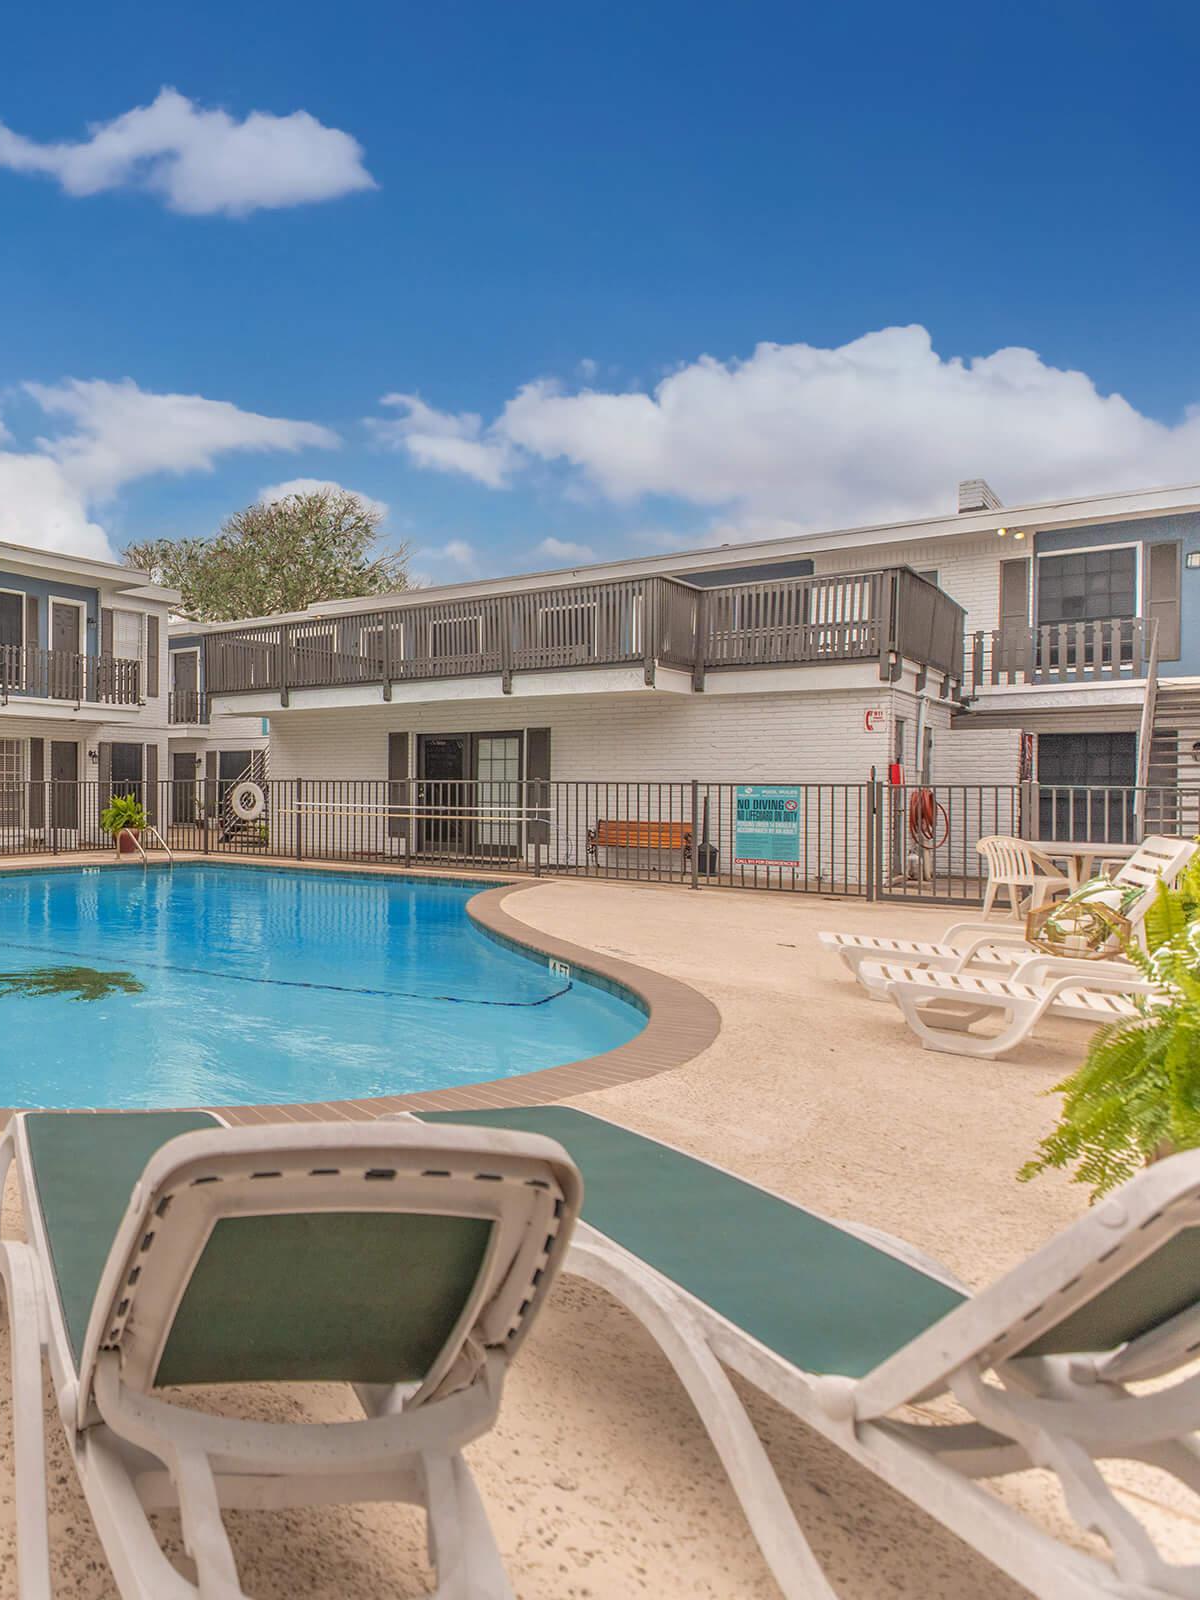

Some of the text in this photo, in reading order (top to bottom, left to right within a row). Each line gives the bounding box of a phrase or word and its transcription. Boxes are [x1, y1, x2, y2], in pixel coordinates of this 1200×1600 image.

[737, 799, 785, 811] NO DIVING
[737, 810, 798, 823] NO LIFEGUARD ON DUTY
